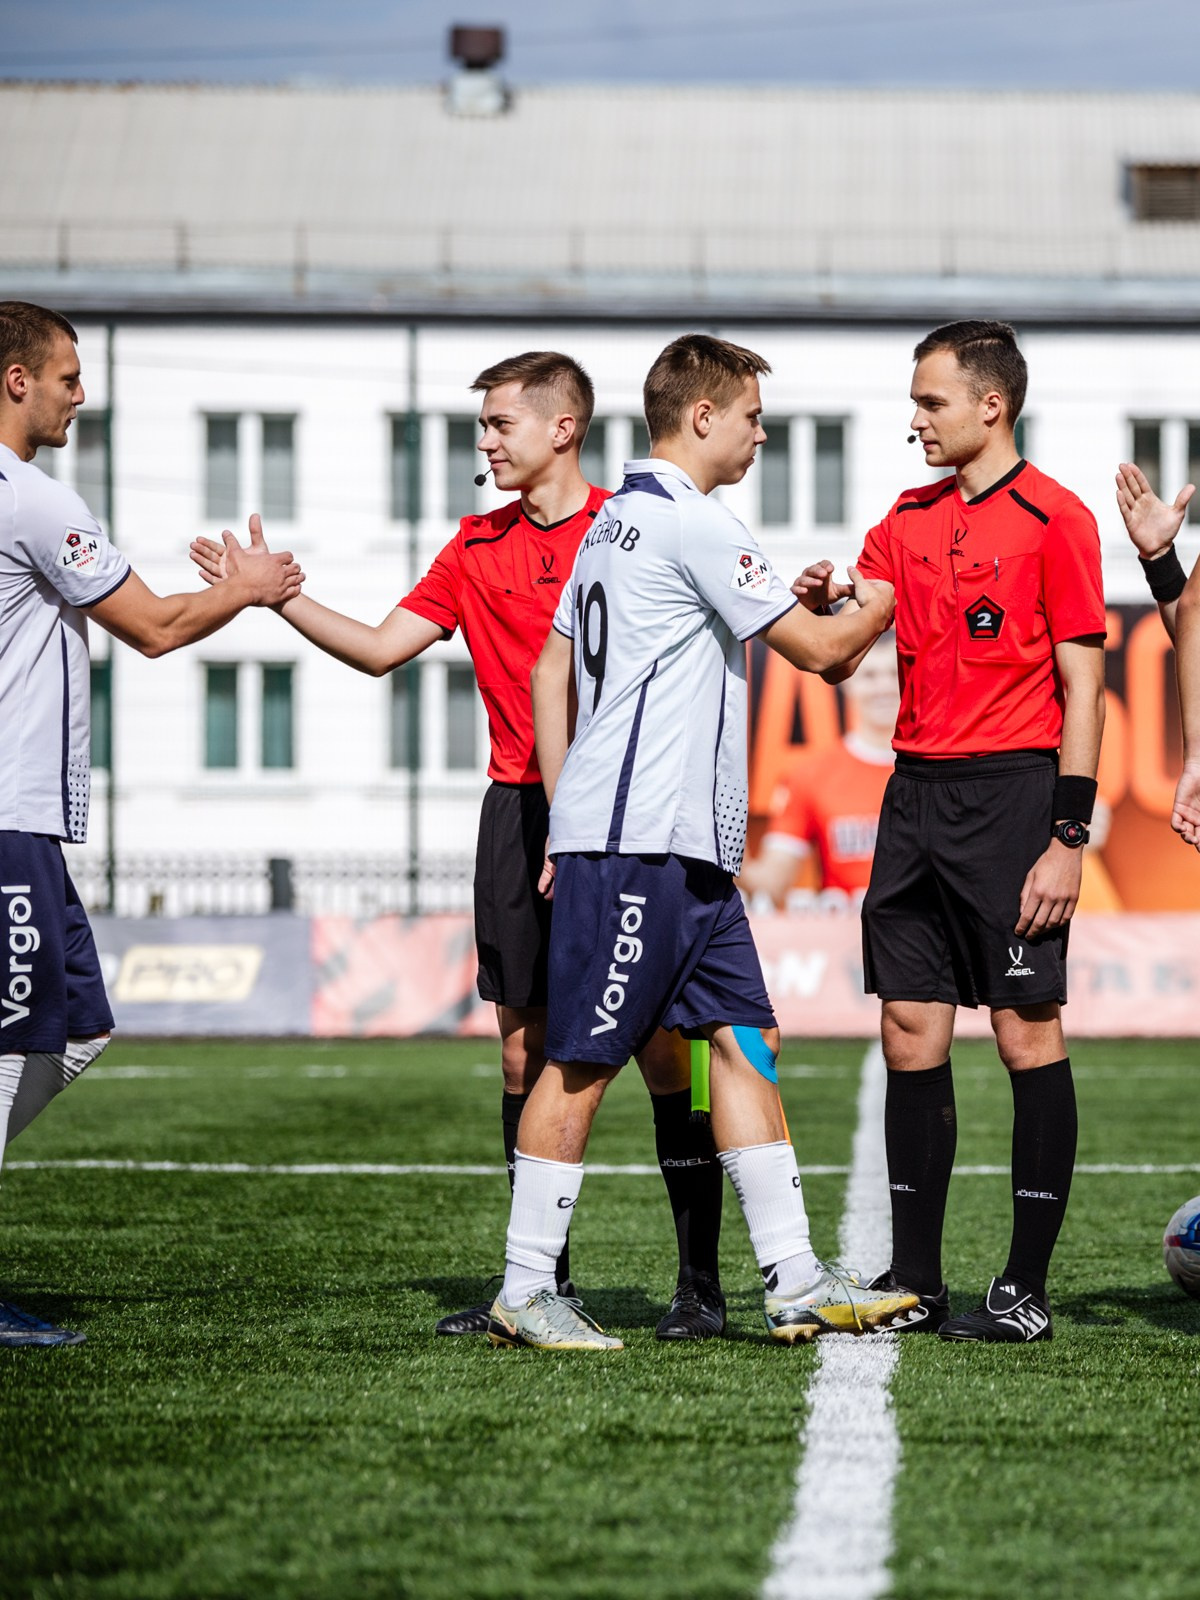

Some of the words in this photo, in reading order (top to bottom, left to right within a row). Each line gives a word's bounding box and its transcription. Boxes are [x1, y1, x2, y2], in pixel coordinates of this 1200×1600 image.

[63, 540, 97, 566] LEON
[738, 563, 767, 587] LEON
[976, 612, 992, 626] 2
[576, 581, 608, 716] 19
[0, 885, 41, 1029] Vorgol
[590, 893, 647, 1036] Vorgol
[1005, 967, 1035, 976] JÖGEL
[660, 1157, 711, 1167] JÖGEL
[1014, 1188, 1058, 1200] JÖGEL
